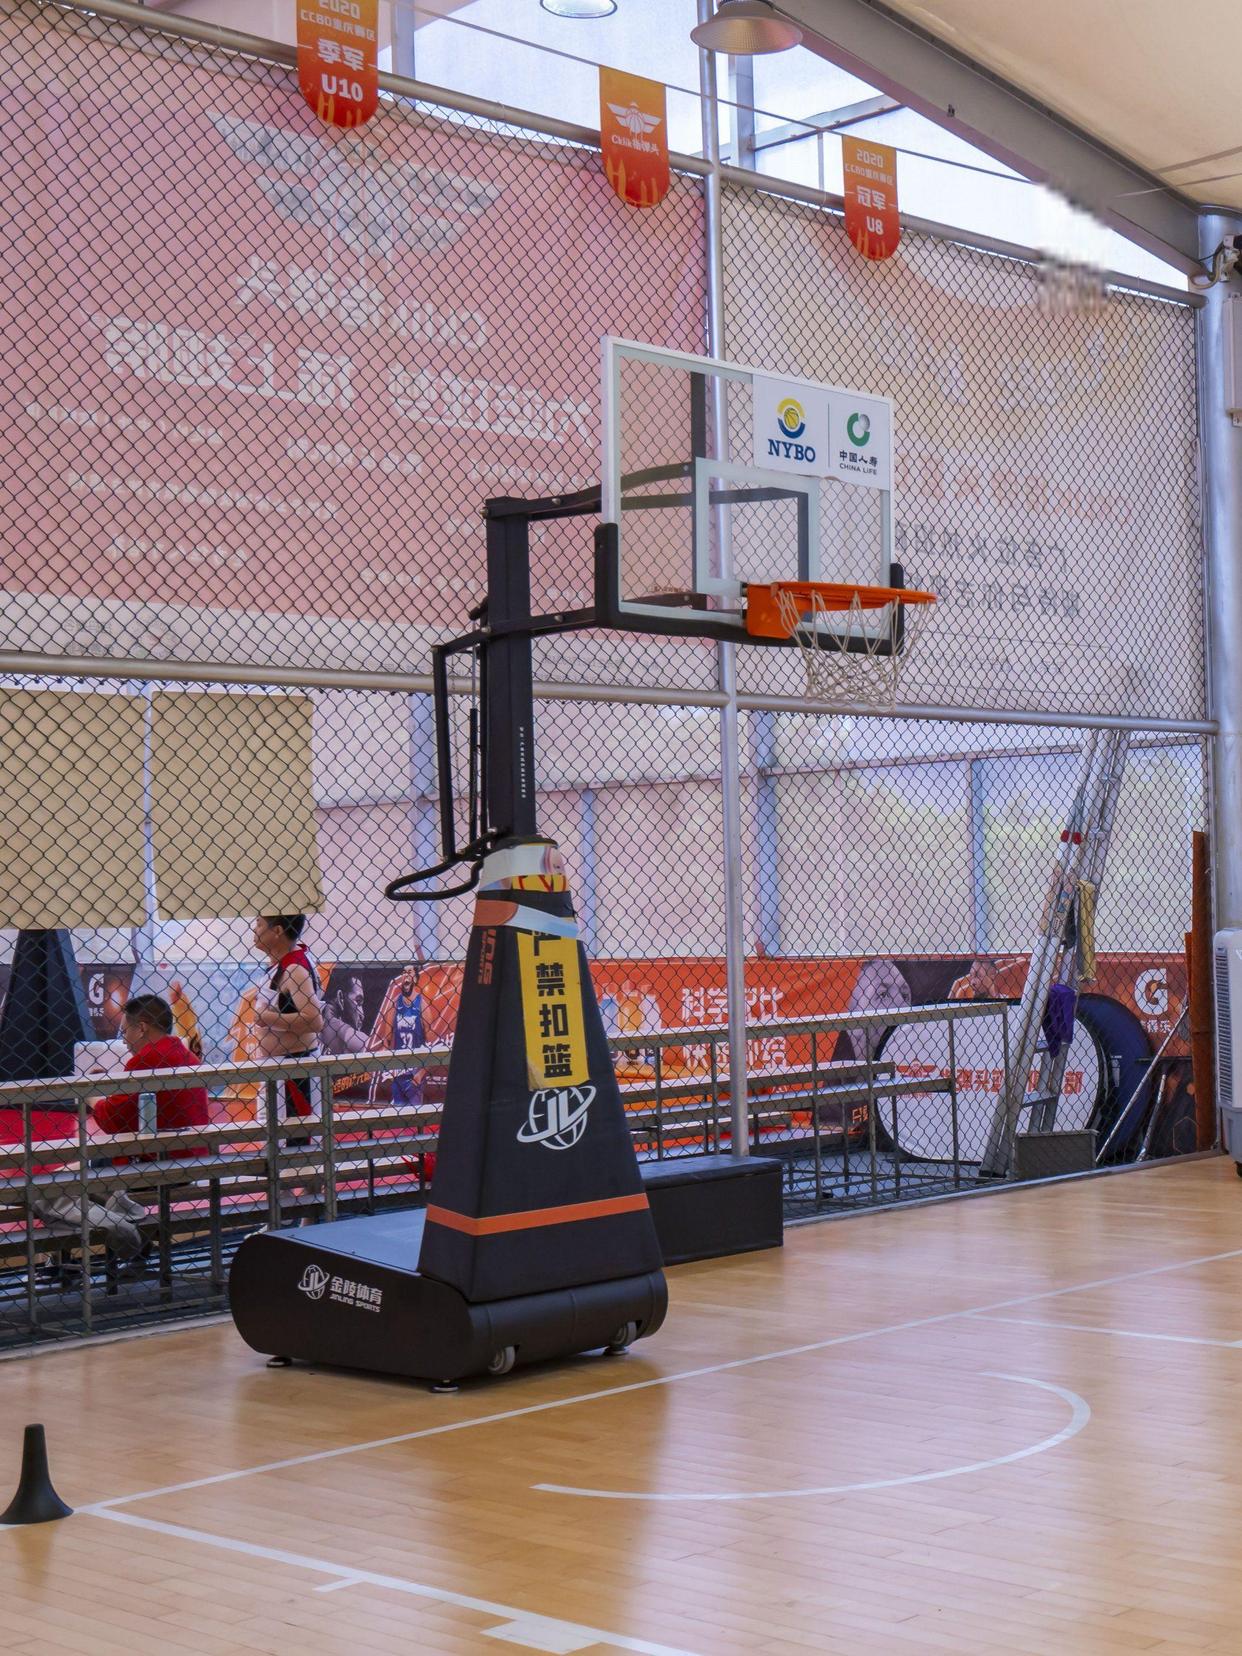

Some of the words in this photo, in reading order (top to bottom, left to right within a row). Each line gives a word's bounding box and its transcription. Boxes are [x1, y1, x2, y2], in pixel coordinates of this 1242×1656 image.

[317, 38, 365, 71] 季军
[321, 73, 363, 103] U10
[856, 148, 884, 168] 2020
[856, 185, 886, 211] 冠军
[866, 215, 884, 235] U8
[767, 439, 816, 463] NYBO
[839, 450, 878, 467] 中国人寿
[839, 462, 861, 473] CHINA
[863, 466, 877, 475] LIFE
[89, 973, 104, 1005] G
[1135, 968, 1168, 1015] G
[330, 1276, 383, 1305] 金陵体育
